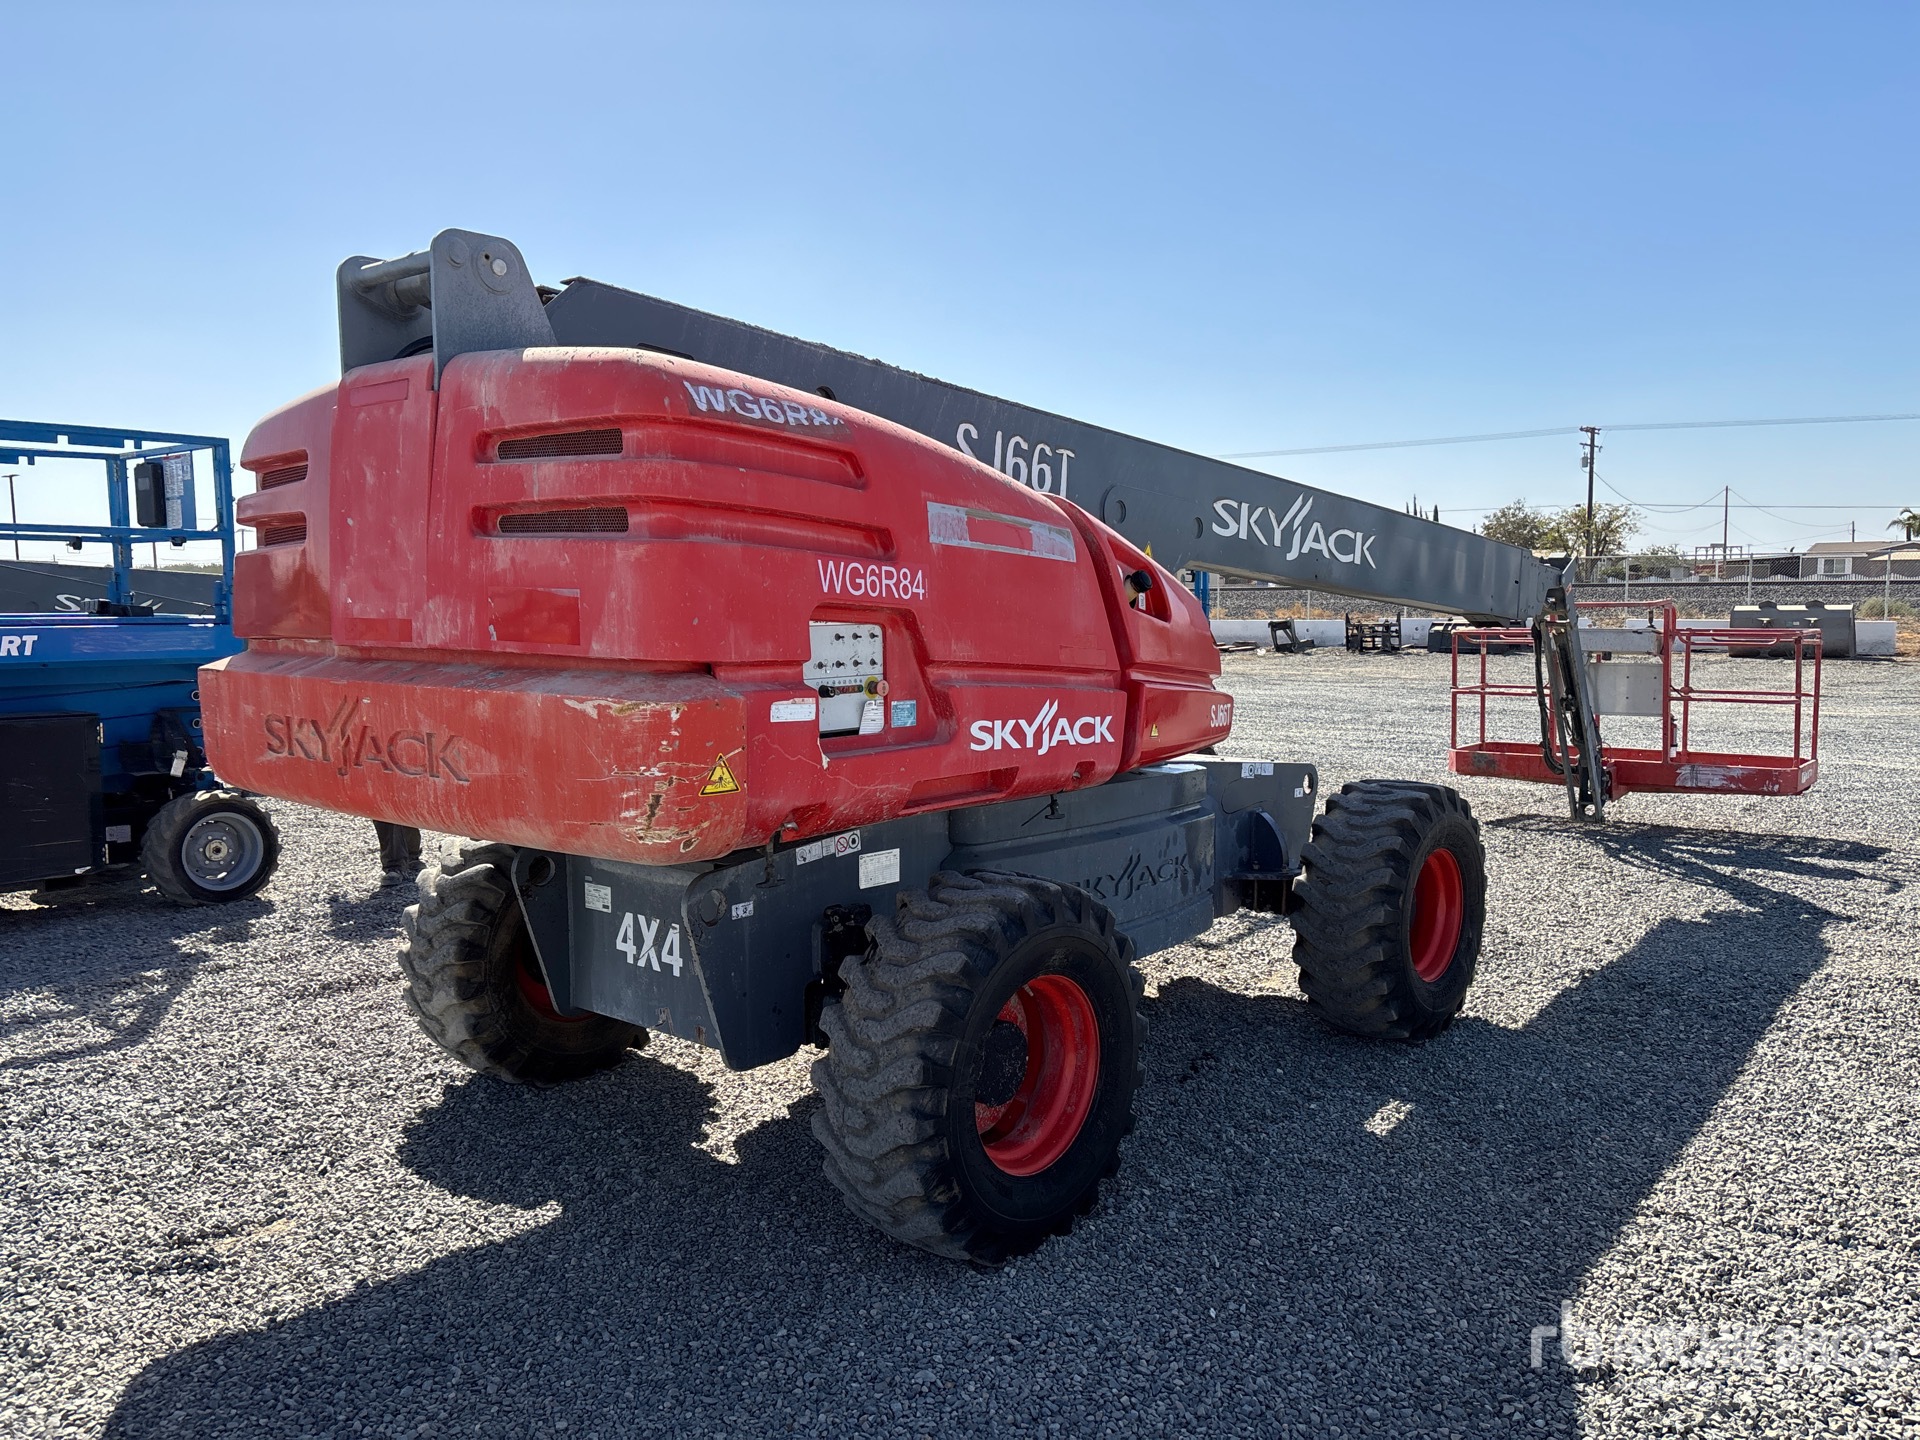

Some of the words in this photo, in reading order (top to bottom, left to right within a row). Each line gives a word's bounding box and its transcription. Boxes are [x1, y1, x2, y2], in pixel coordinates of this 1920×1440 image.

[683, 380, 845, 426] WG6R8
[1211, 492, 1377, 569] SKYJACK
[817, 559, 925, 601] WG6R84
[263, 694, 471, 783] SKYJACK
[970, 698, 1115, 756] SKYJACK
[1210, 703, 1231, 728] SJ66T
[615, 911, 683, 978] 4X4
